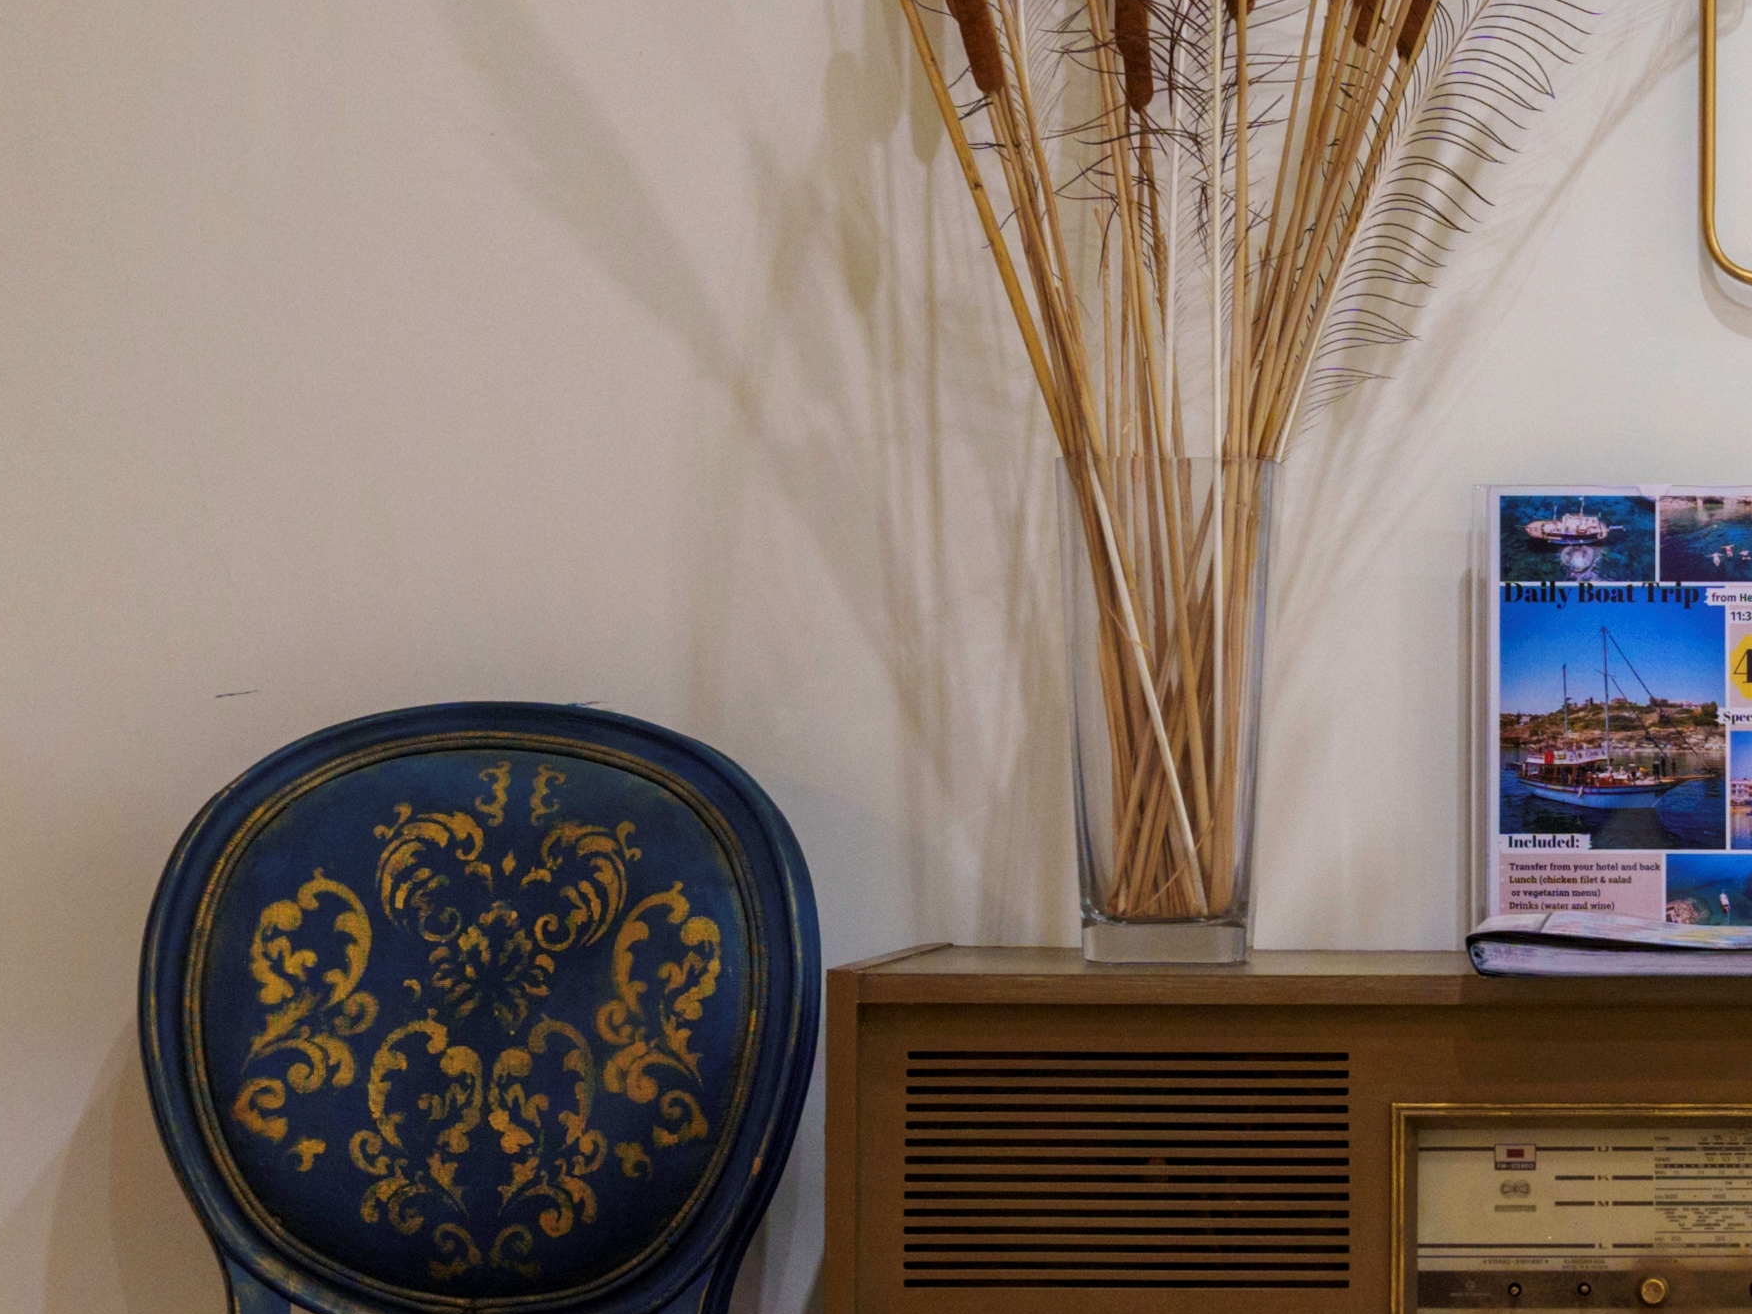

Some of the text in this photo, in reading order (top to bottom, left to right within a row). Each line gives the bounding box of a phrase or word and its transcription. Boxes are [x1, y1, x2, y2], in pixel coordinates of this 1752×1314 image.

[1504, 581, 1699, 609] Daily Boat Trip
[1712, 593, 1736, 602] from
[1508, 835, 1580, 849] Included:
[1509, 863, 1547, 871] Transfer
[1550, 863, 1571, 871] from
[1596, 863, 1618, 871] hotel
[1621, 863, 1637, 871] and
[1639, 863, 1660, 871] back
[1509, 876, 1537, 884] Lunch
[1539, 875, 1577, 885] (chicken
[1580, 875, 1597, 883] filet
[1523, 889, 1569, 898] vegetarian
[1572, 889, 1601, 897] menu)
[1541, 902, 1568, 910] (water
[1590, 902, 1615, 910] wine)
